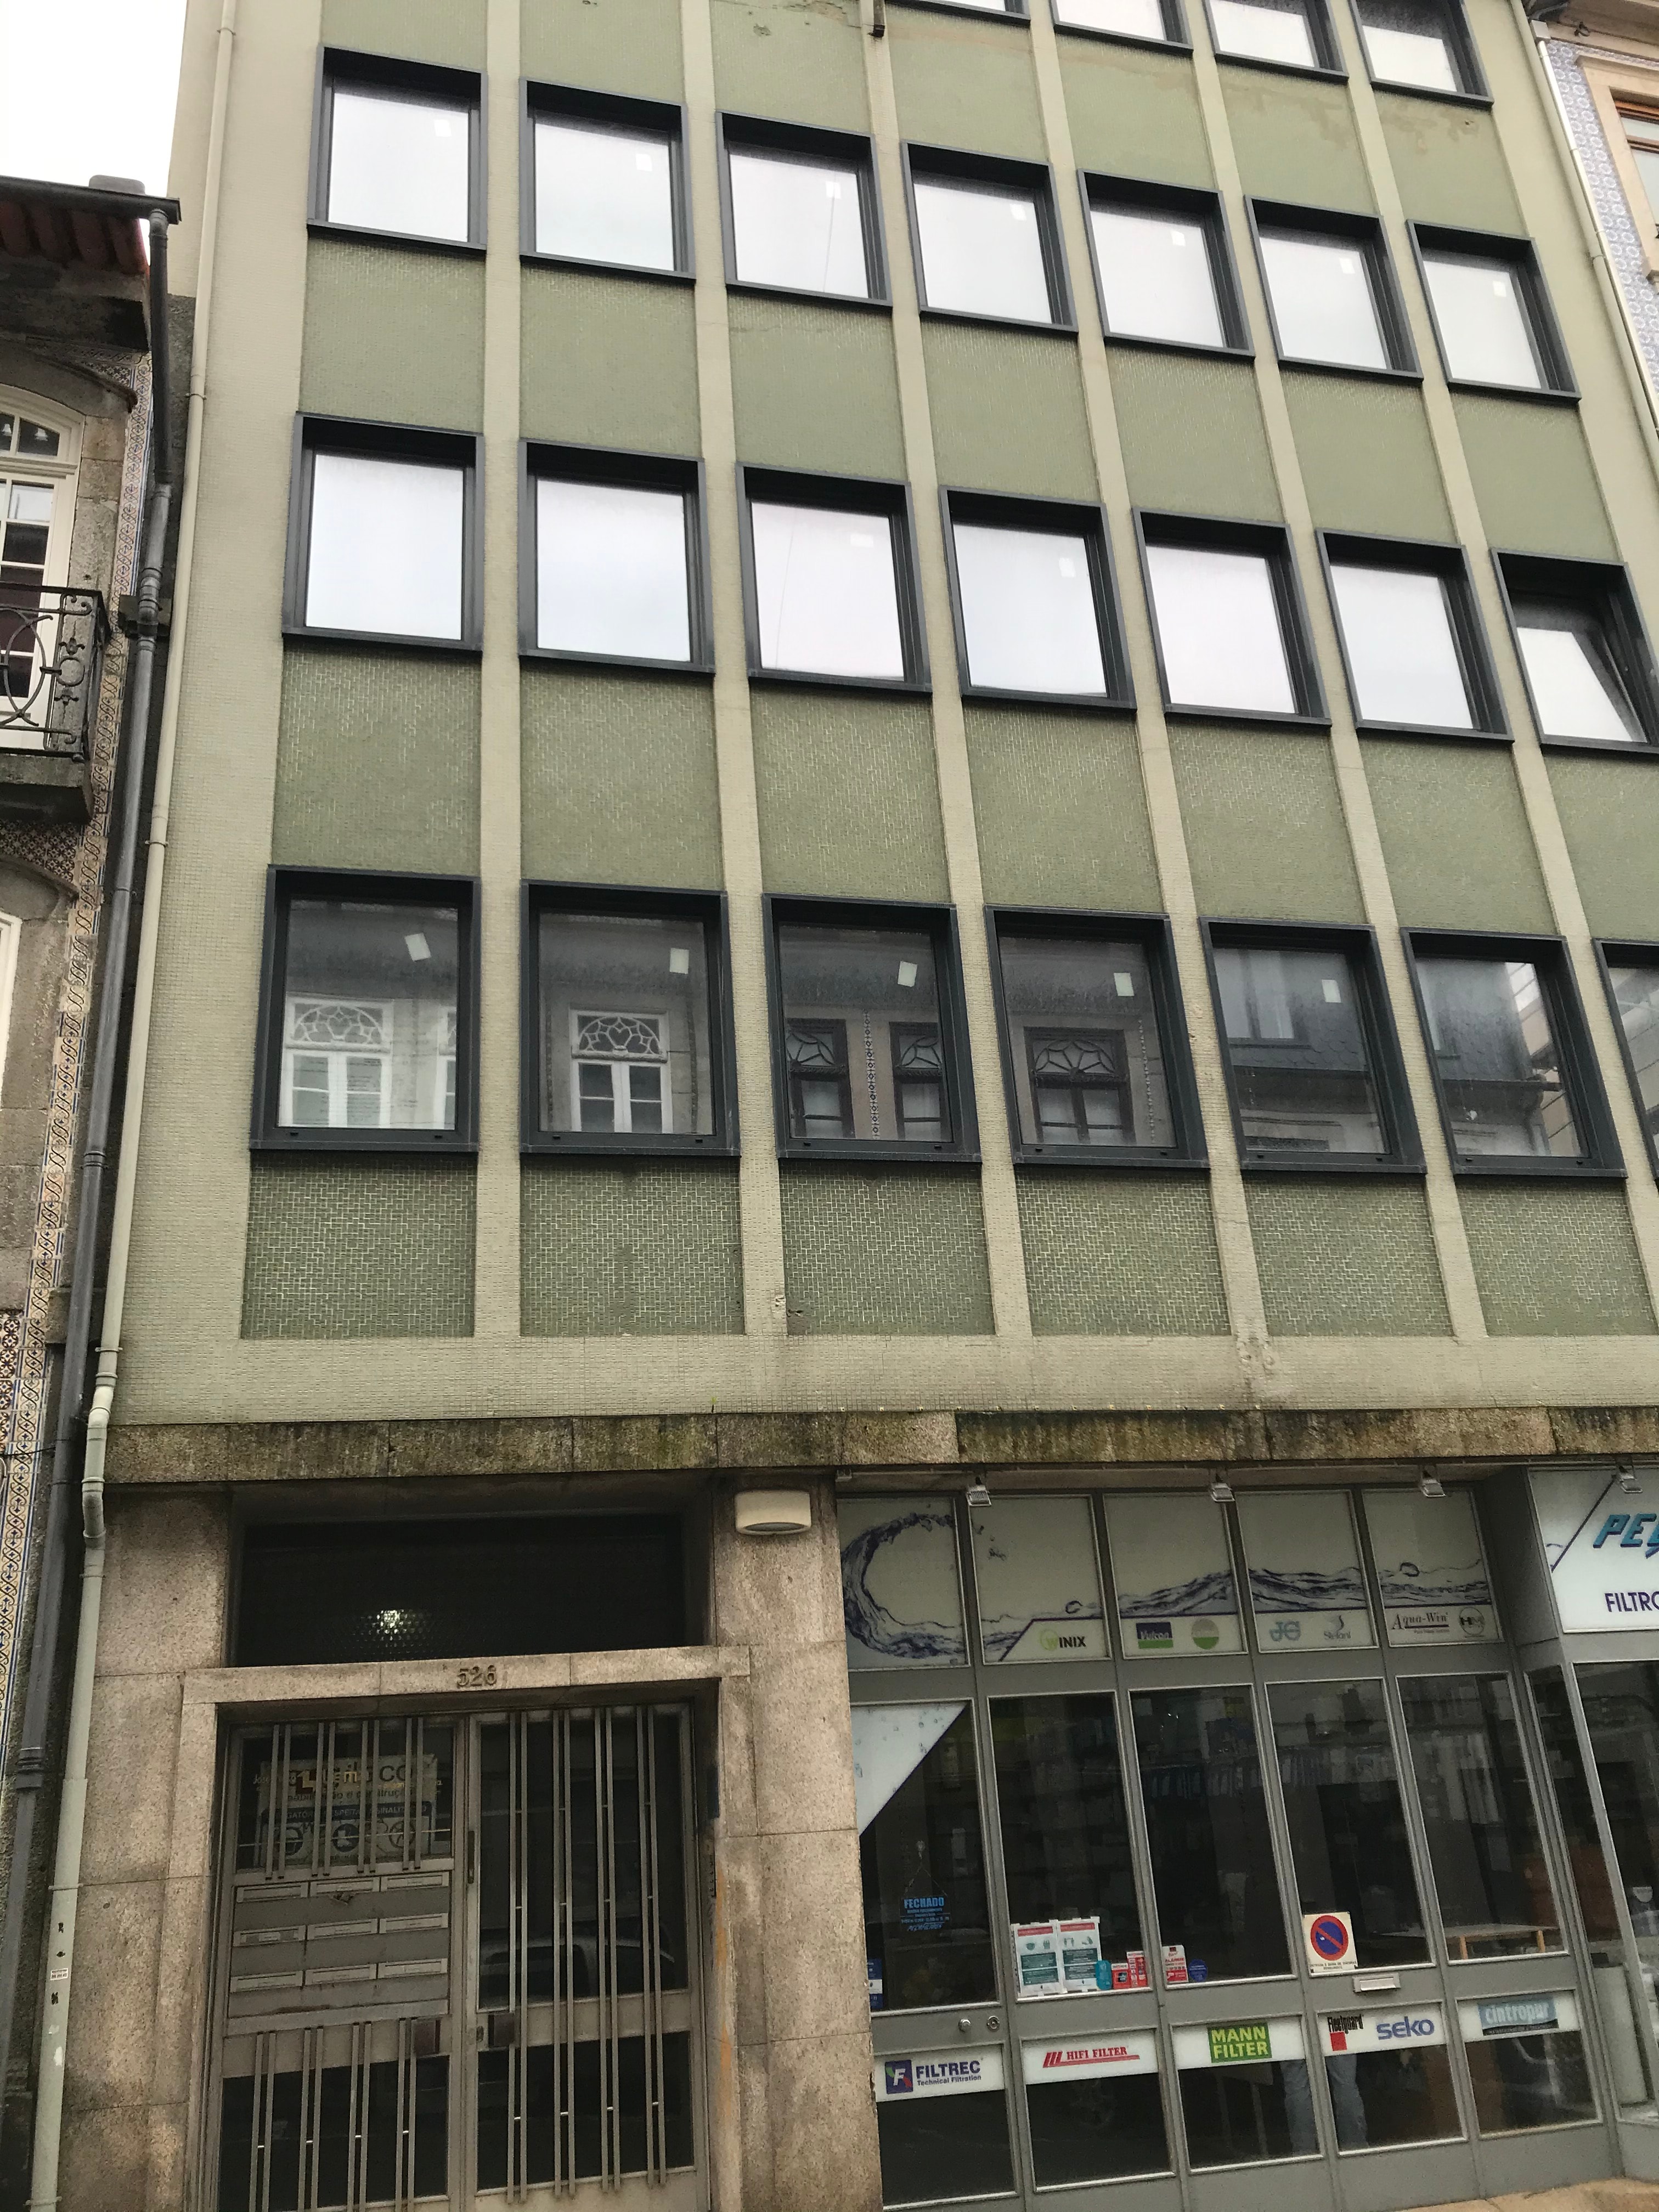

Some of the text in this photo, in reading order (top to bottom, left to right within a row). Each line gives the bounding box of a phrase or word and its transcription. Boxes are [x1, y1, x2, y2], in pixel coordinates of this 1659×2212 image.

[456, 1664, 497, 1689] 526
[904, 1897, 945, 1909] FECHADO
[1327, 2014, 1364, 2034] Fleetguard
[1211, 2026, 1266, 2044] MANN
[1066, 2046, 1128, 2060] HIFI FILTER
[1213, 2041, 1268, 2059] FILTER
[916, 2060, 981, 2079] FILTREC
[917, 2074, 981, 2086] Technical Filtration
